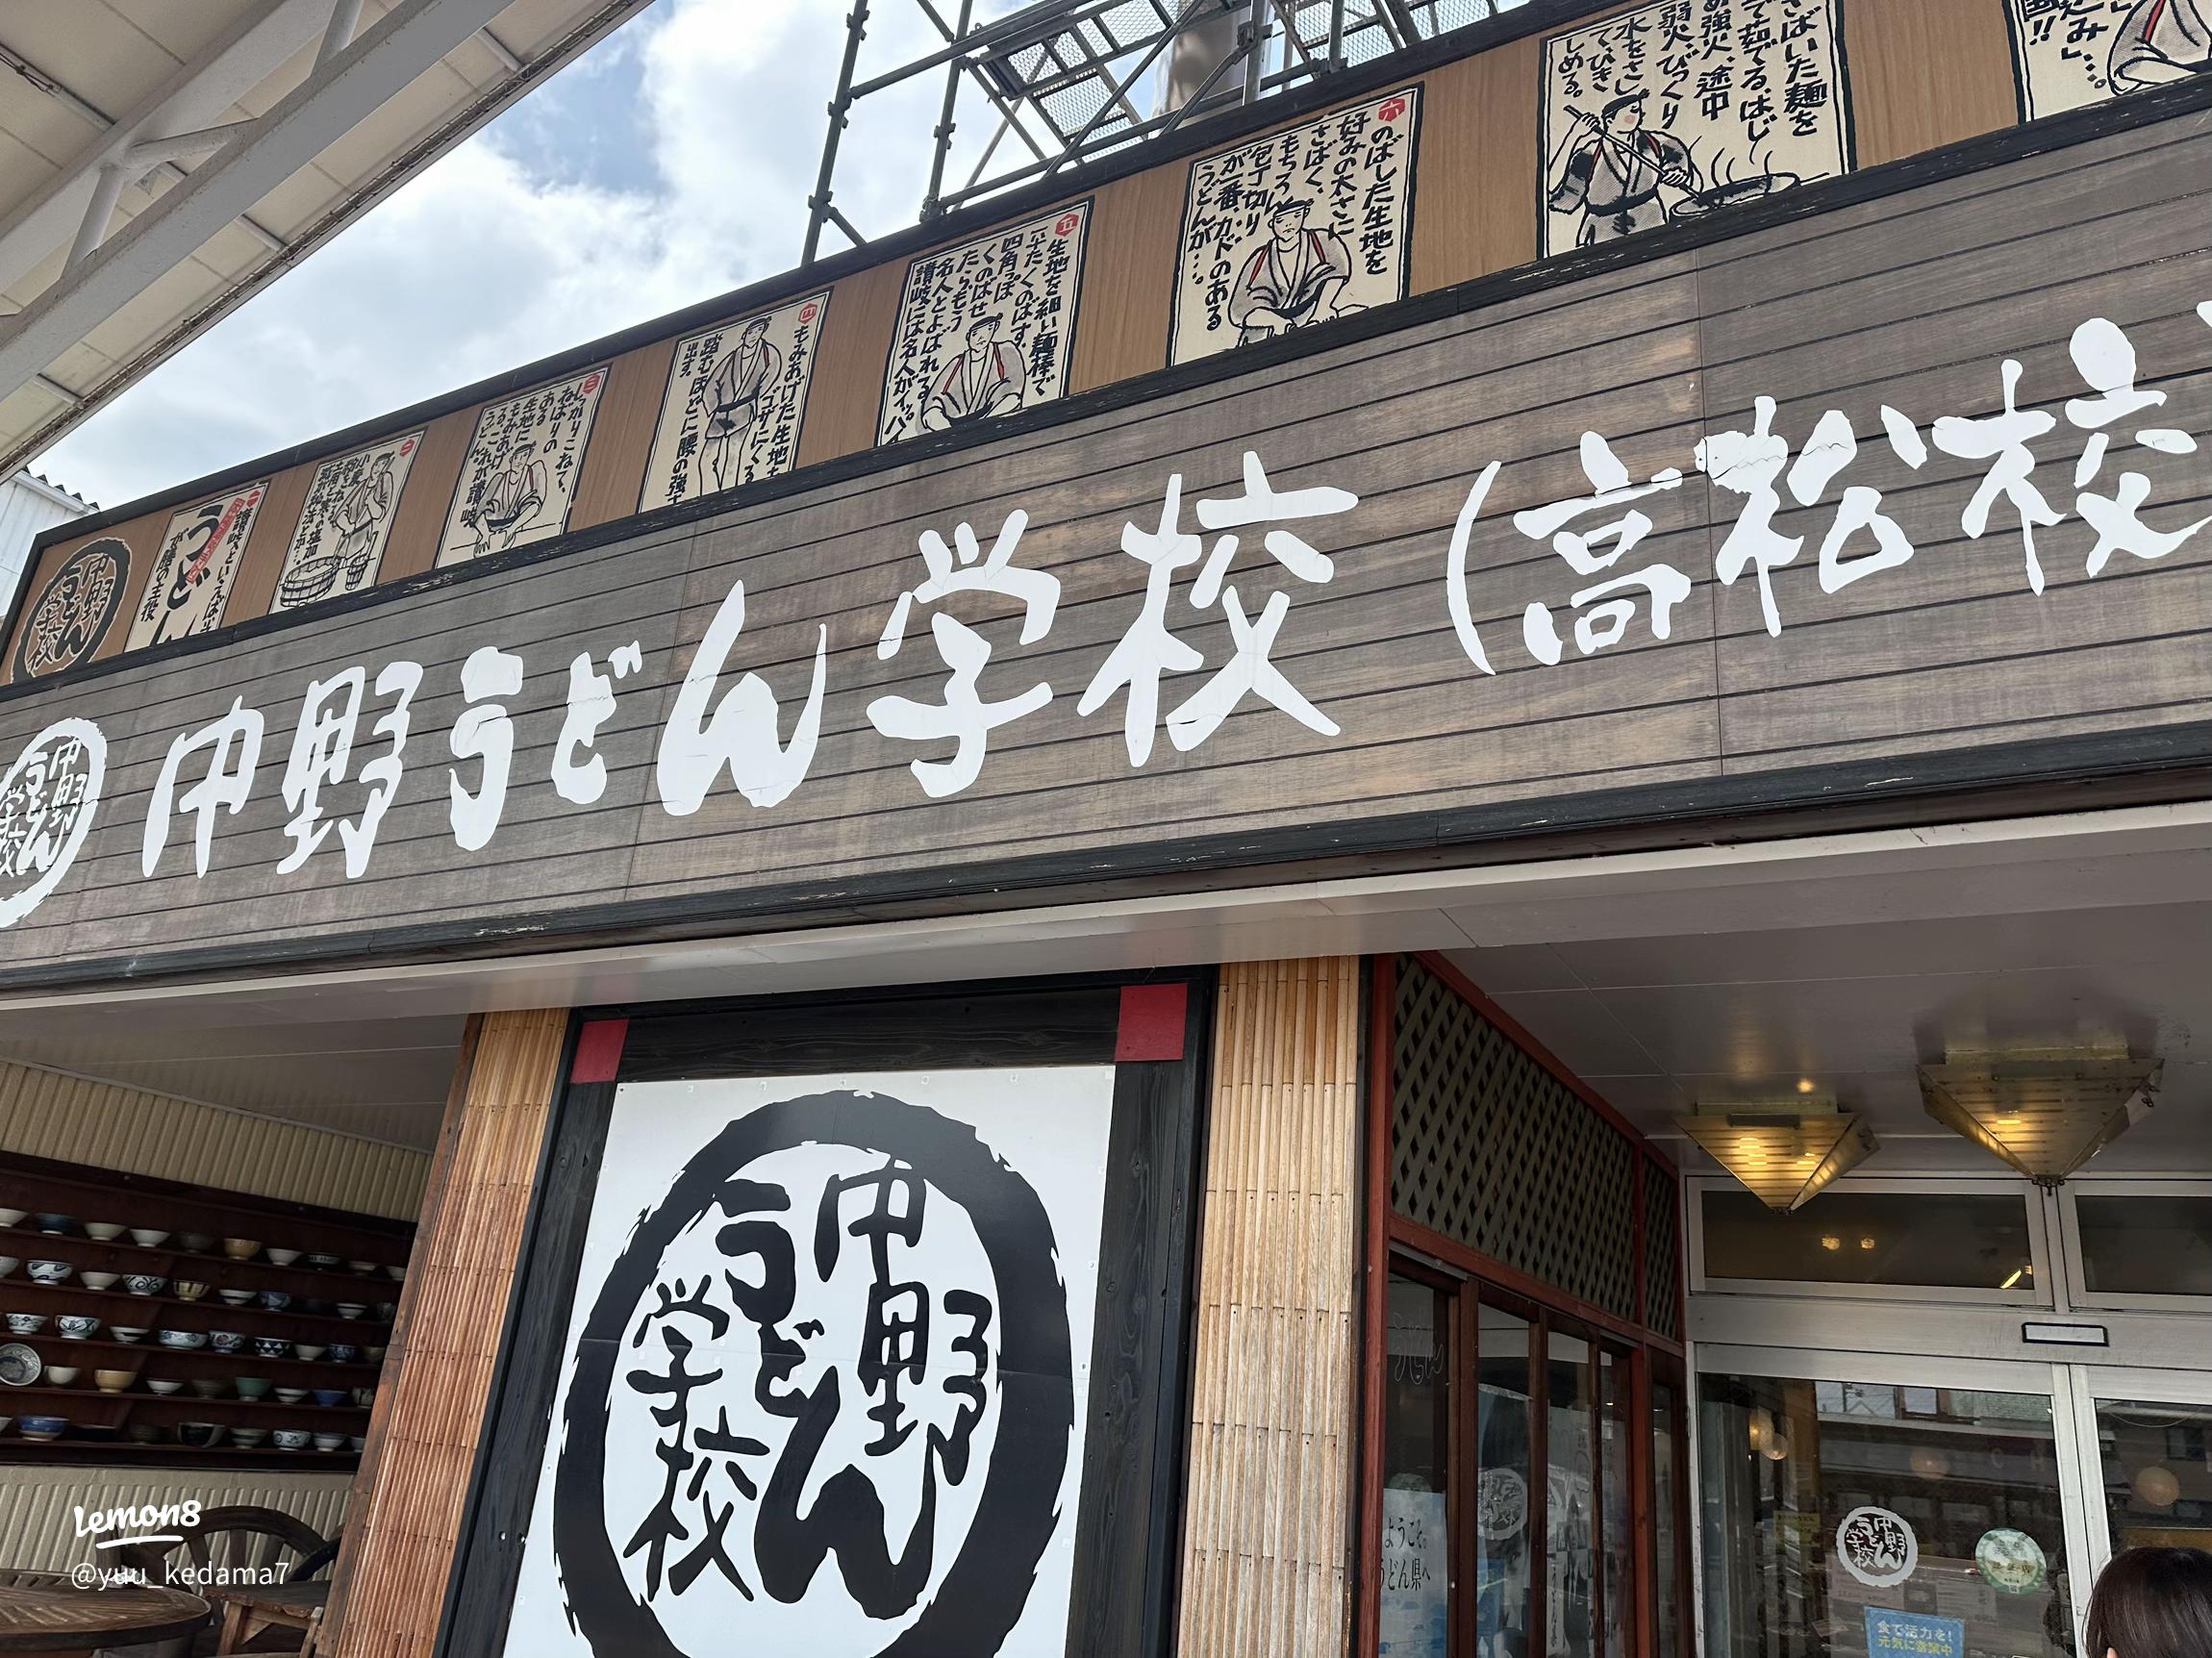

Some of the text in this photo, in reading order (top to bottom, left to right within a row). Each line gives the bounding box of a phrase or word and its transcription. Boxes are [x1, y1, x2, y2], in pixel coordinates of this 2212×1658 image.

[1557, 38, 1586, 98] しめる。
[1615, 17, 1652, 95] 水をさし
[1656, 4, 1699, 129] 弱火、びっくり
[1241, 142, 1274, 238] 包丁切り
[1264, 135, 1299, 216] もちろん
[1303, 124, 1339, 194] さばく、
[1359, 126, 1404, 275] のばした生地を
[968, 242, 997, 318] くのばせ
[1027, 239, 1068, 396] 生地を細い麺棒で
[917, 258, 955, 401] 名人とよばれる
[489, 402, 520, 470] もみあげ
[515, 396, 539, 443] 生地に
[536, 391, 555, 427] ある
[542, 386, 577, 454] ねばりの
[555, 382, 587, 493] しっかりこねて、
[81, 554, 113, 624] 中野
[50, 737, 88, 831] 中野
[814, 1153, 993, 1488] 中野
[623, 1274, 771, 1602] 学校
[715, 1178, 937, 1620] うどん
[1846, 1527, 1875, 1569] 学校
[1856, 1517, 1902, 1570] うどん
[1873, 1516, 1905, 1558] 中野
